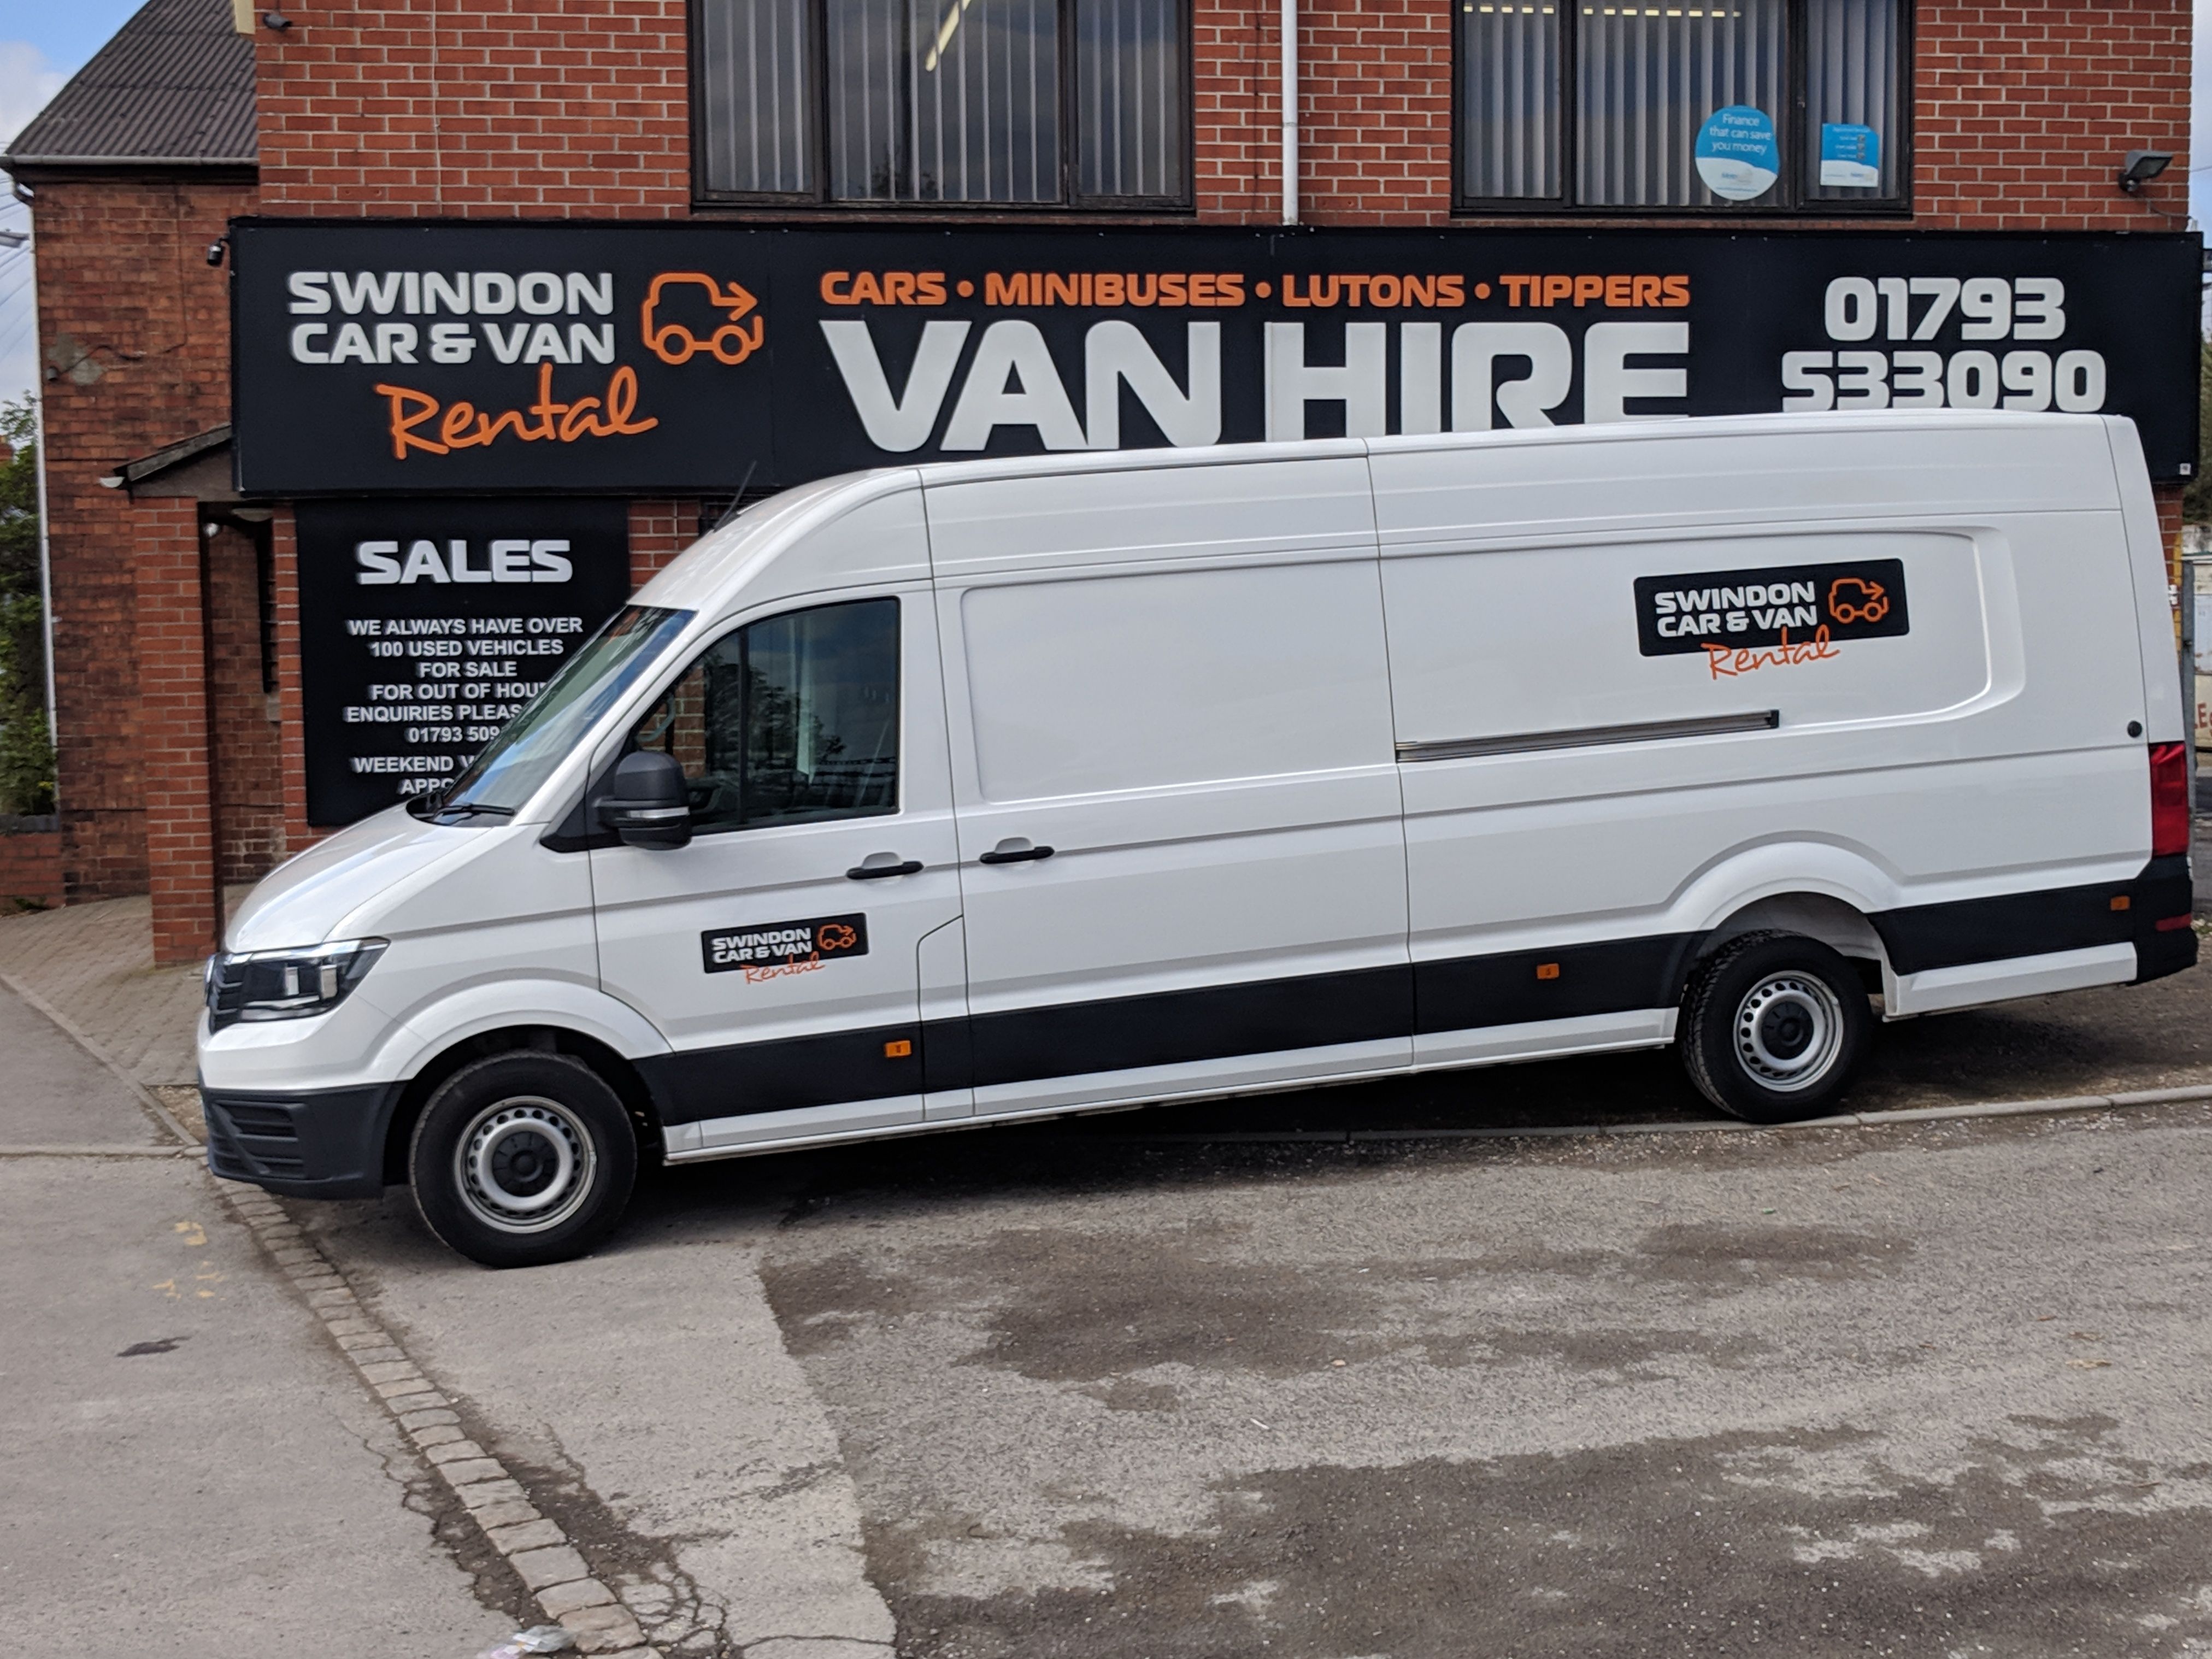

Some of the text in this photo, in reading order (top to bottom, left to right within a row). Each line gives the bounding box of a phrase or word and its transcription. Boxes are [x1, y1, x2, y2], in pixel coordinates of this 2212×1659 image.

[1709, 126, 1773, 141] that can save
[1722, 113, 1760, 127] Finance
[1711, 142, 1768, 156] you money
[289, 272, 613, 315] SWINDON
[820, 271, 1691, 308] CARS MINIBUSES LUTONS TIPPERS
[1825, 276, 2066, 342] 01793
[291, 322, 614, 364] CAR & VAN
[819, 320, 1690, 452] VAN HIRE
[1781, 350, 2106, 412] 533090
[374, 362, 658, 460] Rental
[356, 539, 573, 585] SALES
[1655, 581, 1816, 615] SWINDON
[347, 617, 583, 636] WE ALWAYS HAVE OVER
[1657, 605, 1817, 638] CAR & VAN
[370, 639, 564, 657] 100 USED VEHICLES
[1701, 624, 1840, 681] Rental
[419, 661, 517, 678] FOR SALE
[370, 682, 547, 700] FOR OUT OF HOU
[346, 705, 454, 722] ENQUIRIES
[408, 726, 463, 743] 01793
[353, 756, 454, 773] WEEKEND
[712, 927, 811, 951] SWINDON
[713, 940, 813, 963] CAR & VAN
[739, 951, 826, 984] Rental
